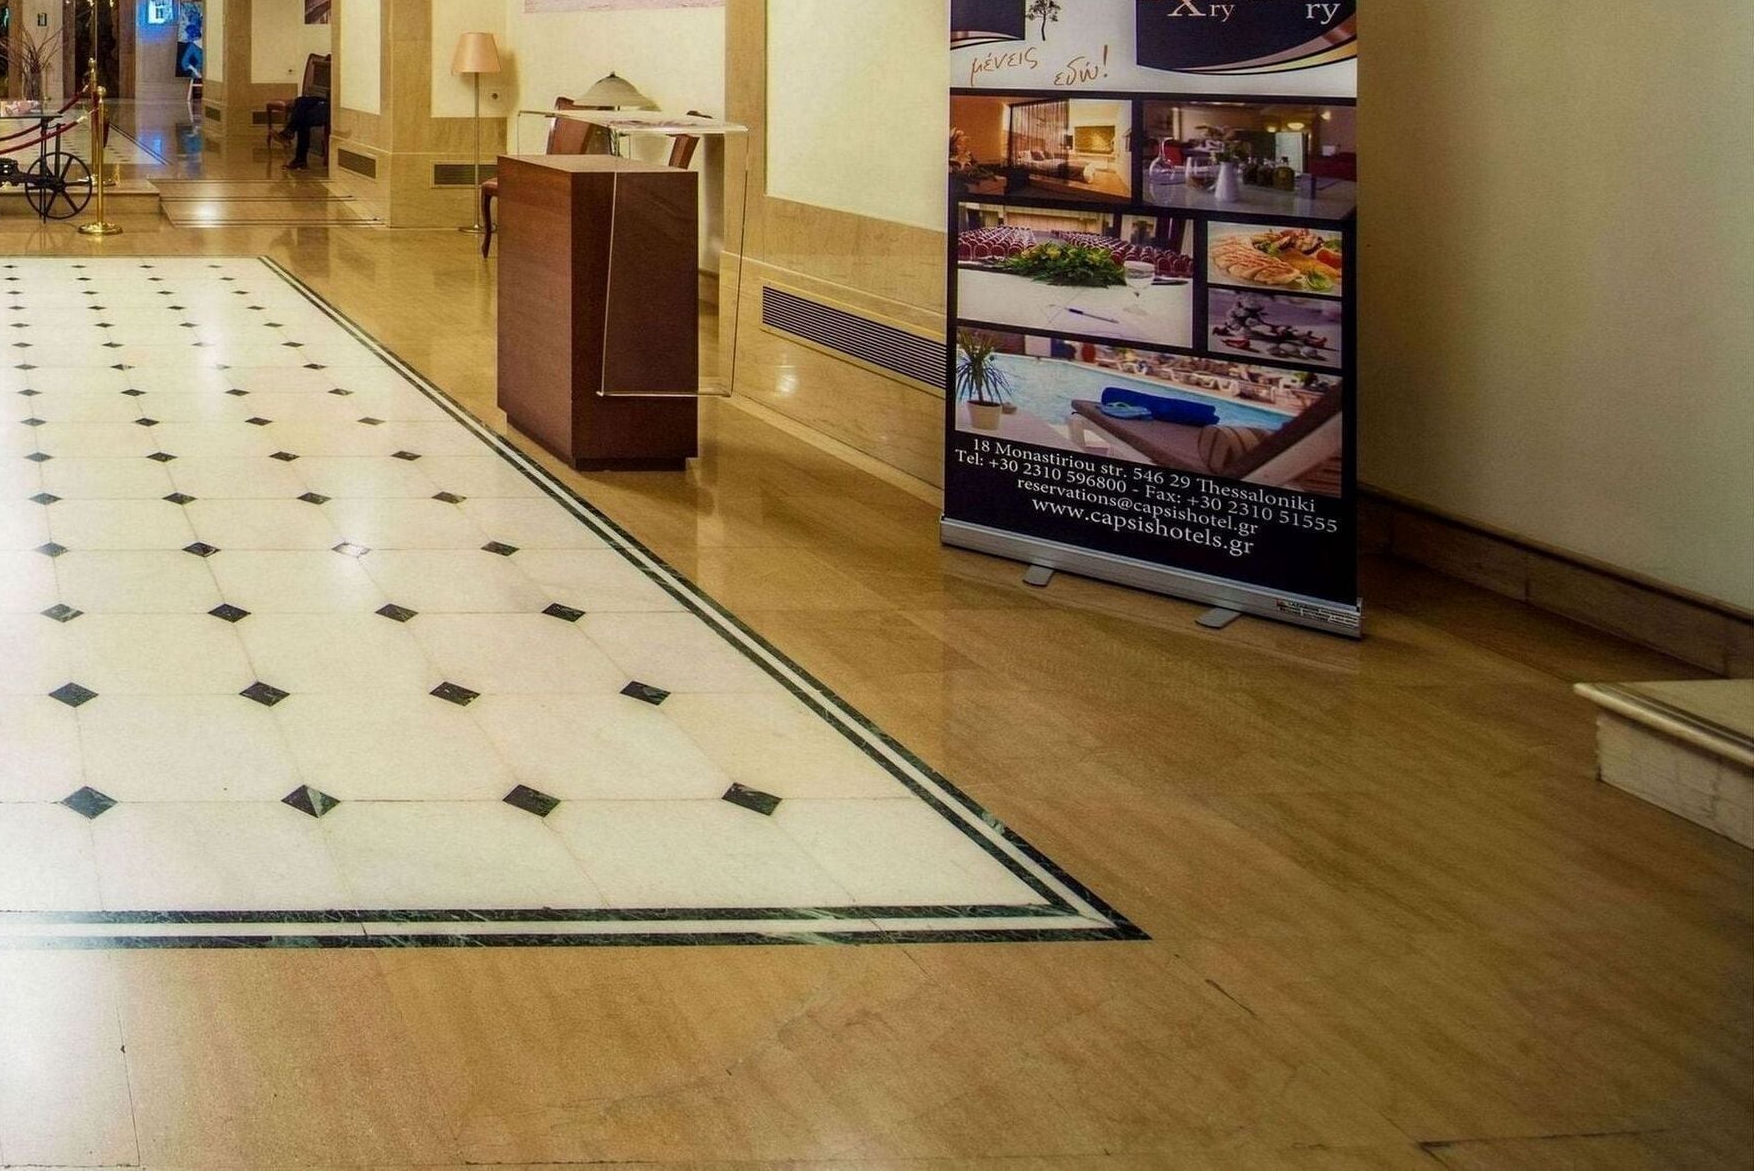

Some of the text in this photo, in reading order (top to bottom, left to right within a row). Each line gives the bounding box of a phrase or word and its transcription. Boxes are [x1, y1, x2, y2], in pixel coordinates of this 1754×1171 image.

[970, 46, 1038, 87] μένεις
[955, 449, 984, 467] Tel:
[988, 458, 1018, 473] +30
[1023, 462, 1061, 481] 2310
[1066, 470, 1127, 493] 596800
[1145, 484, 1181, 504] Fax:
[1187, 495, 1222, 511] +30
[1228, 501, 1273, 521] 2310
[1279, 510, 1338, 533] 51555
[973, 438, 1316, 513] 18 Monastiriou str. 546 29 Thessaloniki
[1017, 478, 1258, 537] reservations@capsishotel.gr
[1032, 498, 1254, 557] www.capsishotels.gr
